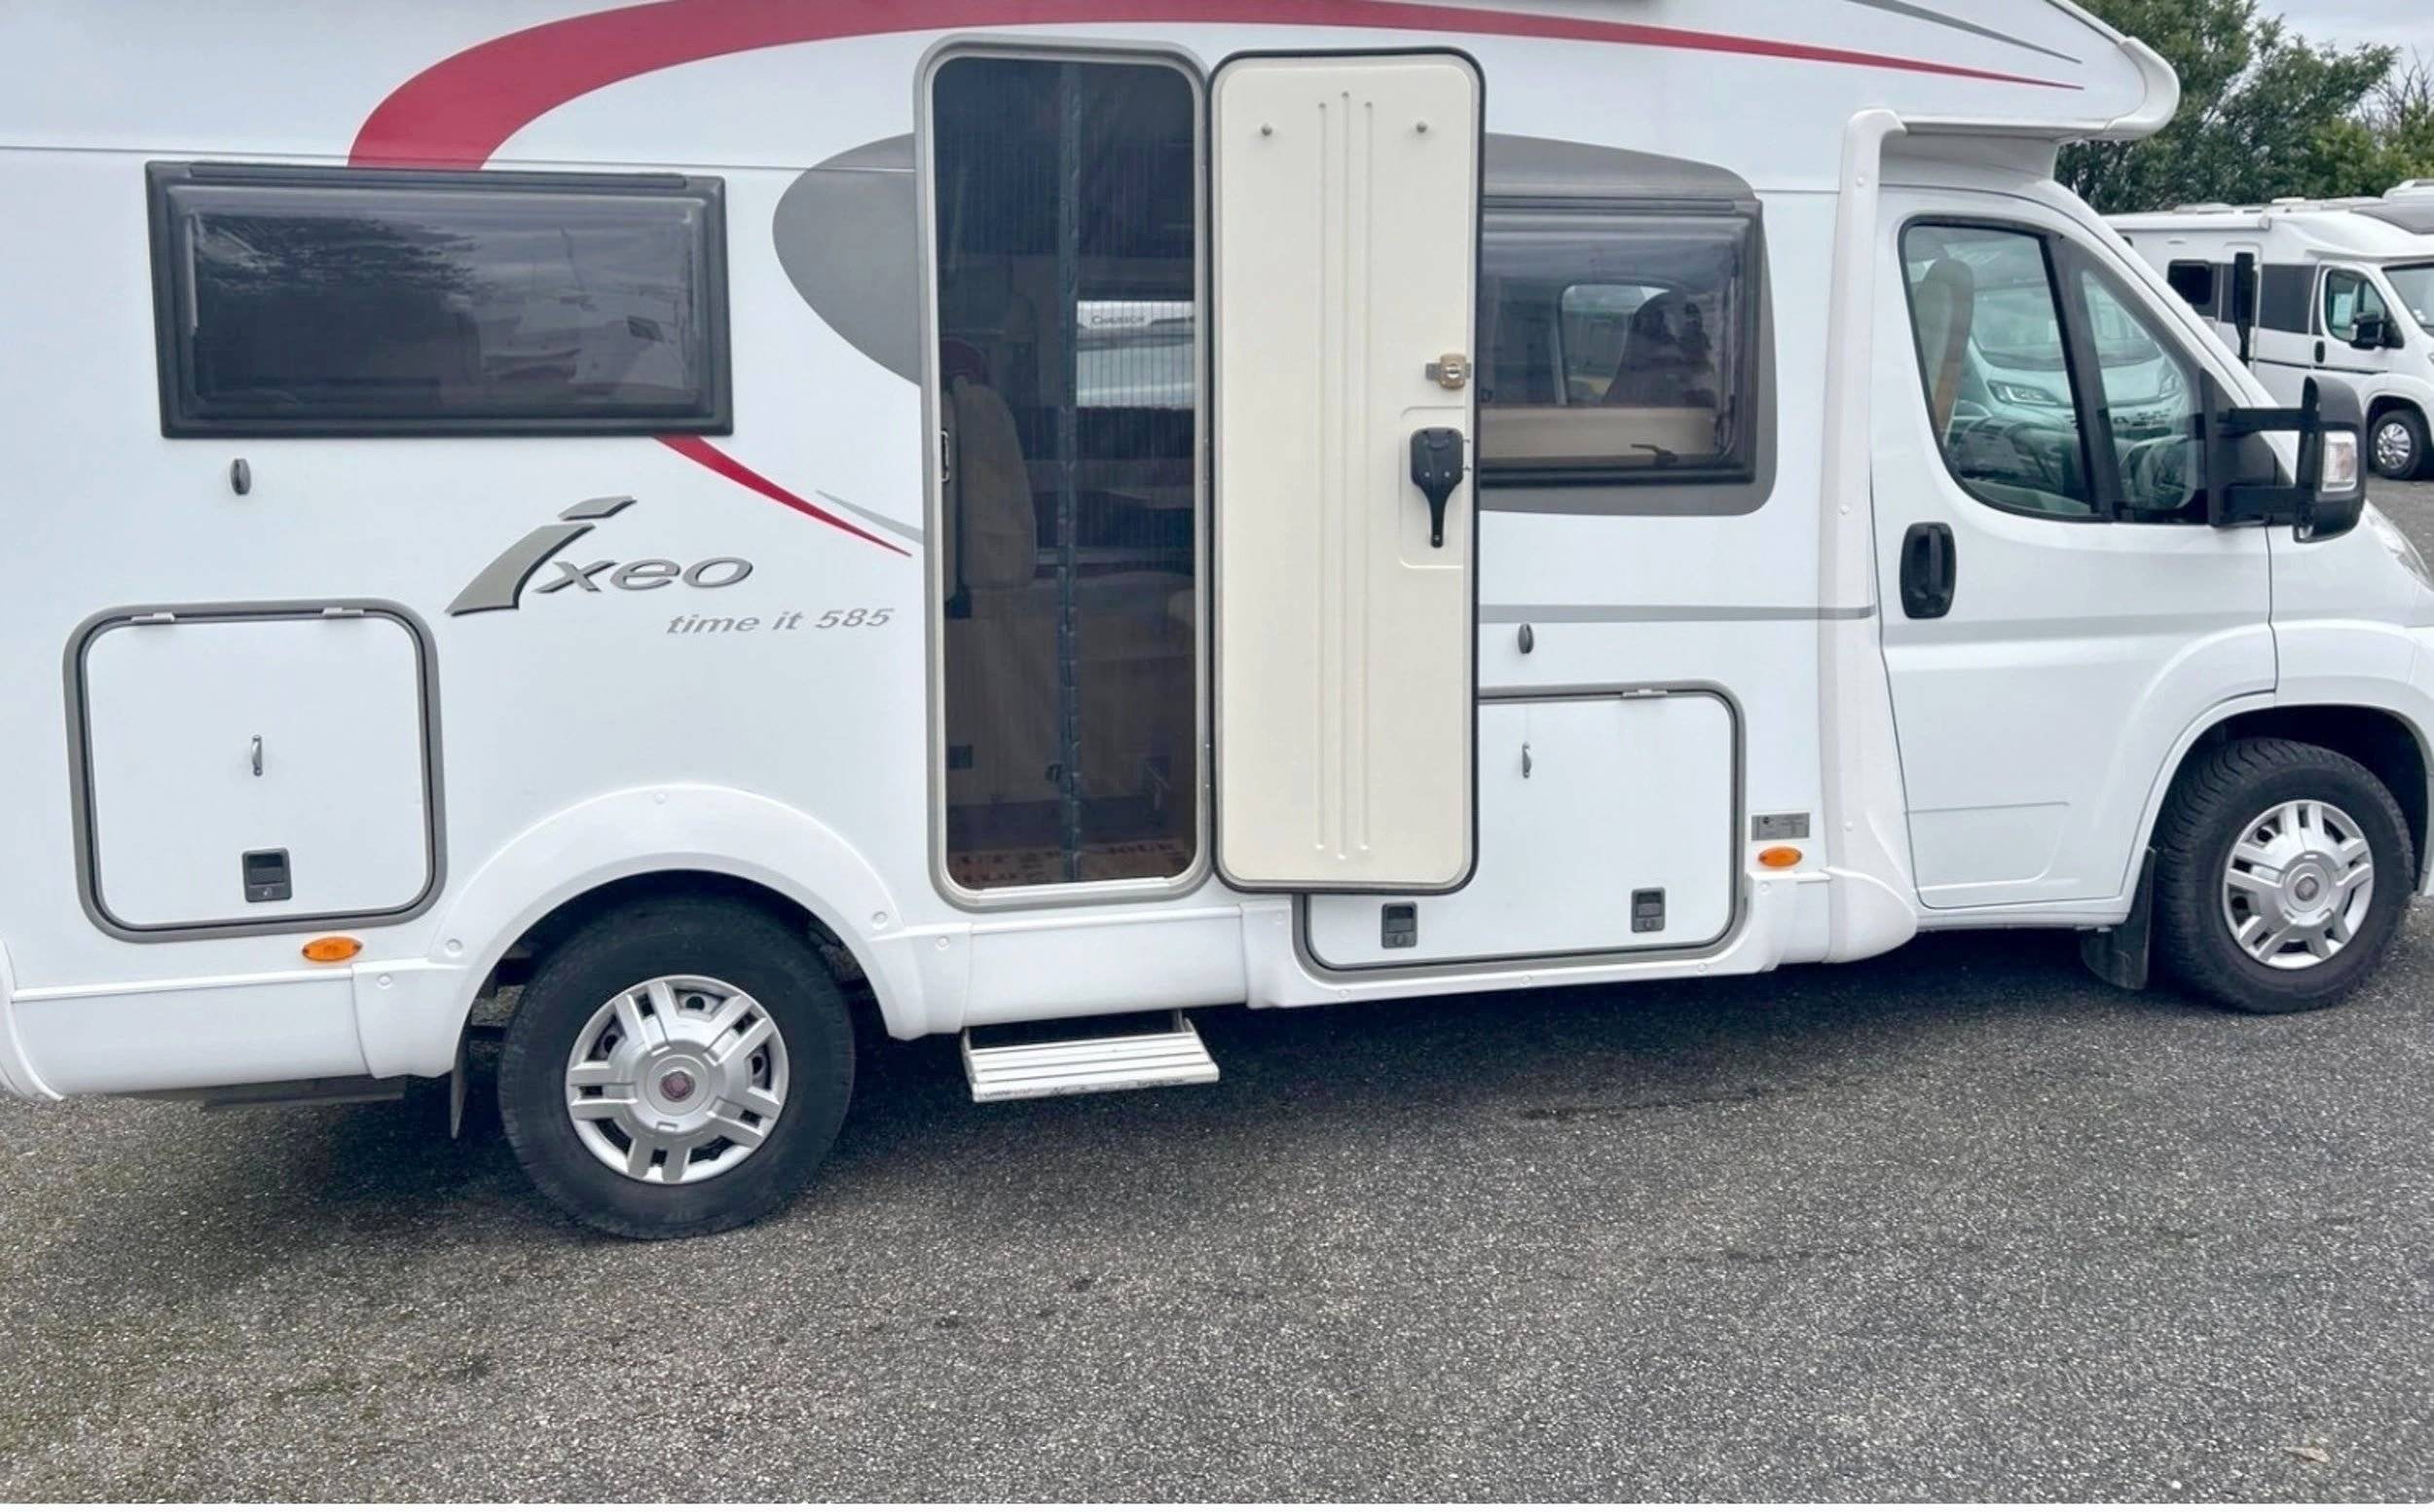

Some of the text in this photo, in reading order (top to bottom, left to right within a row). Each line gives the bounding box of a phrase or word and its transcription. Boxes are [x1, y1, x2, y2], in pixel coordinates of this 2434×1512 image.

[666, 608, 896, 634] time it 585
